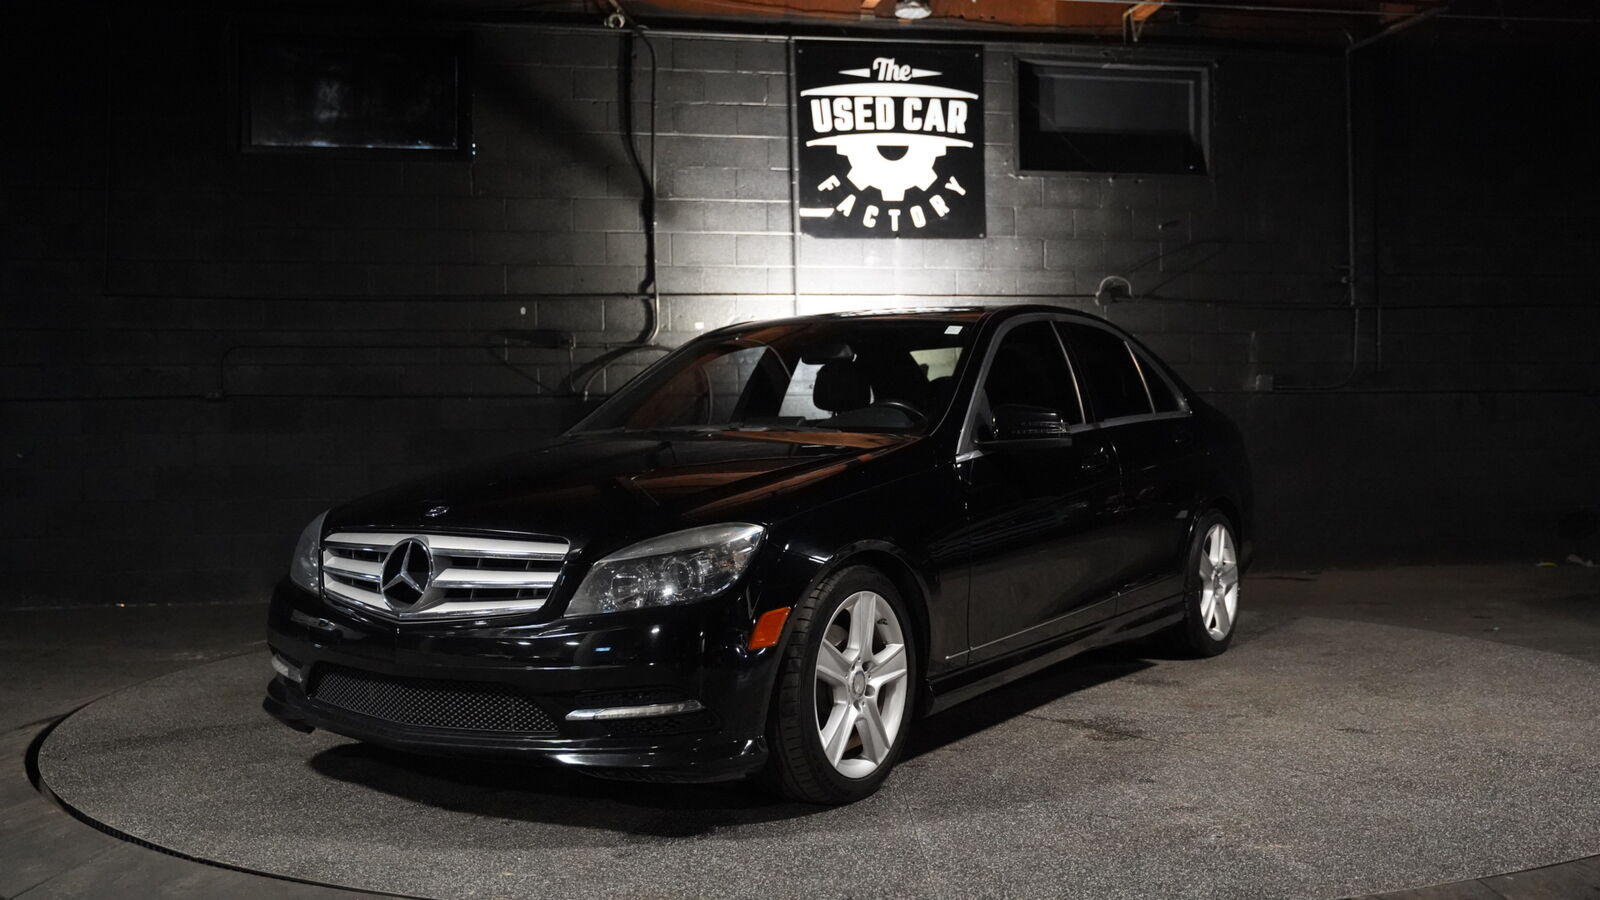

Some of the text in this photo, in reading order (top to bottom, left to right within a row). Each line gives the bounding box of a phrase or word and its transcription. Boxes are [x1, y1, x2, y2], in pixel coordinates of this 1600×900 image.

[873, 57, 913, 81] The
[810, 97, 968, 134] USED CAR
[817, 174, 967, 231] FACTORY
